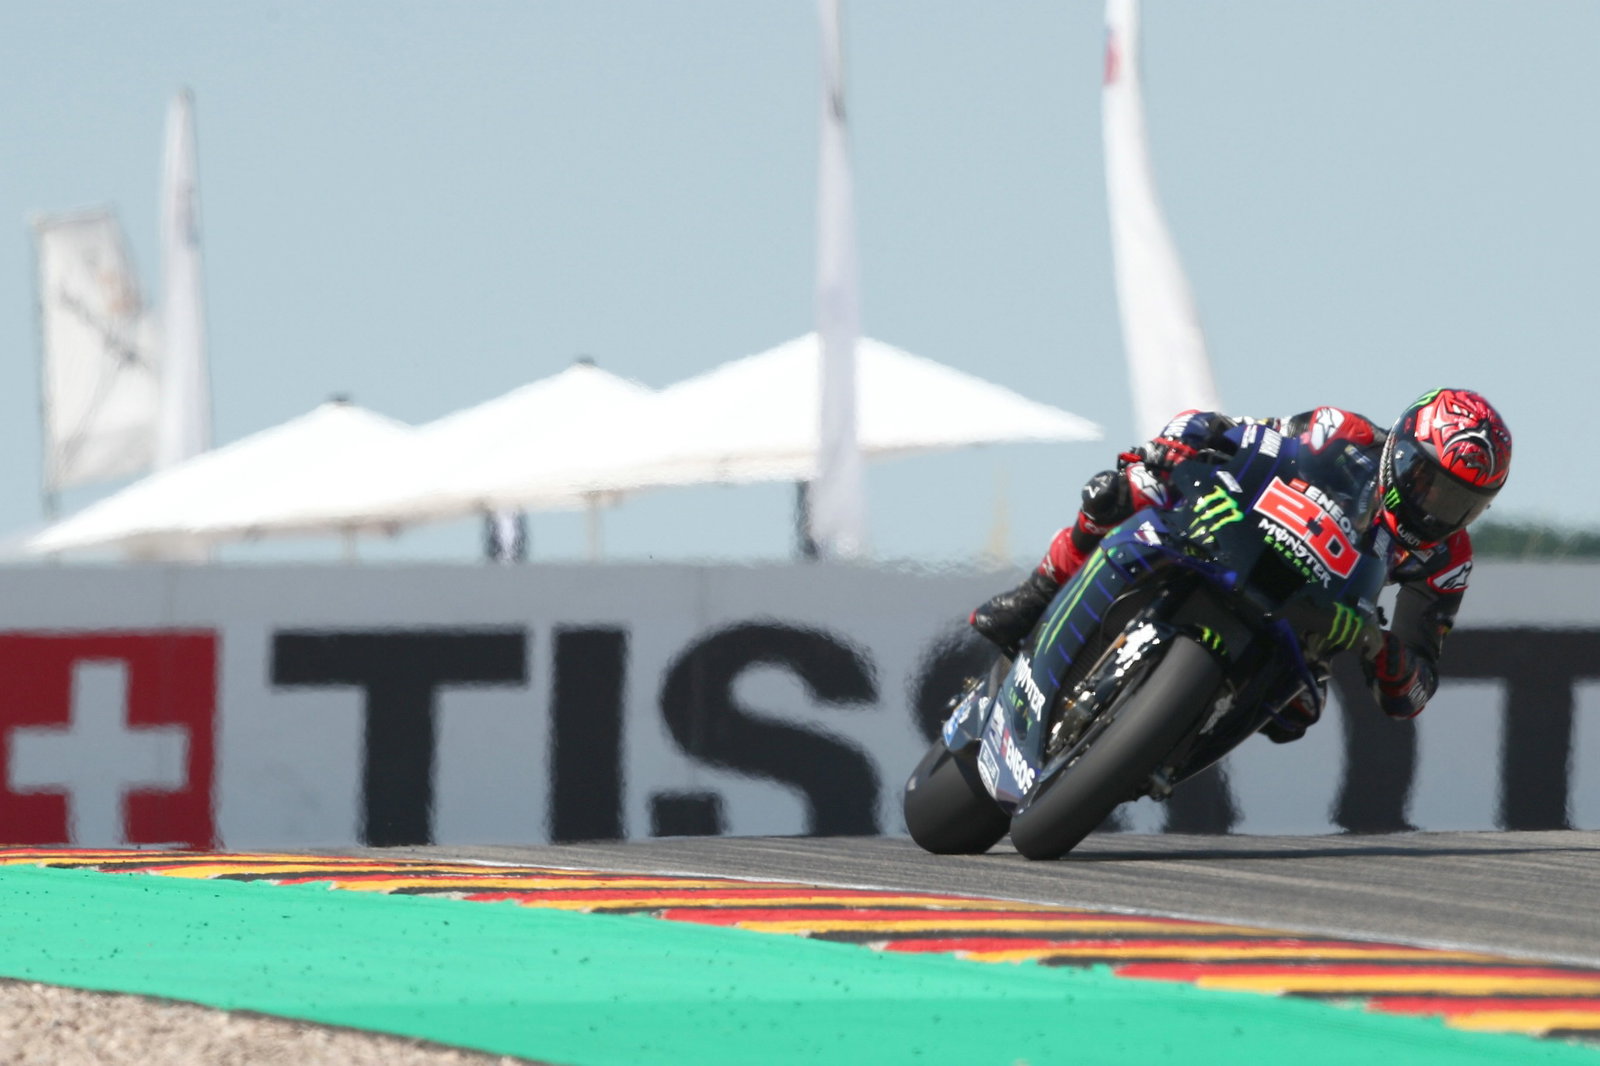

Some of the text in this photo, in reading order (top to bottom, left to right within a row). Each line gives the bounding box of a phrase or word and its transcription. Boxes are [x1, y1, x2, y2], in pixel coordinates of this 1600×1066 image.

[1304, 485, 1358, 546] ENEOS
[1258, 518, 1332, 589] MONSTER
[1263, 535, 1319, 584] ENERGY
[270, 619, 1600, 847] TIST
